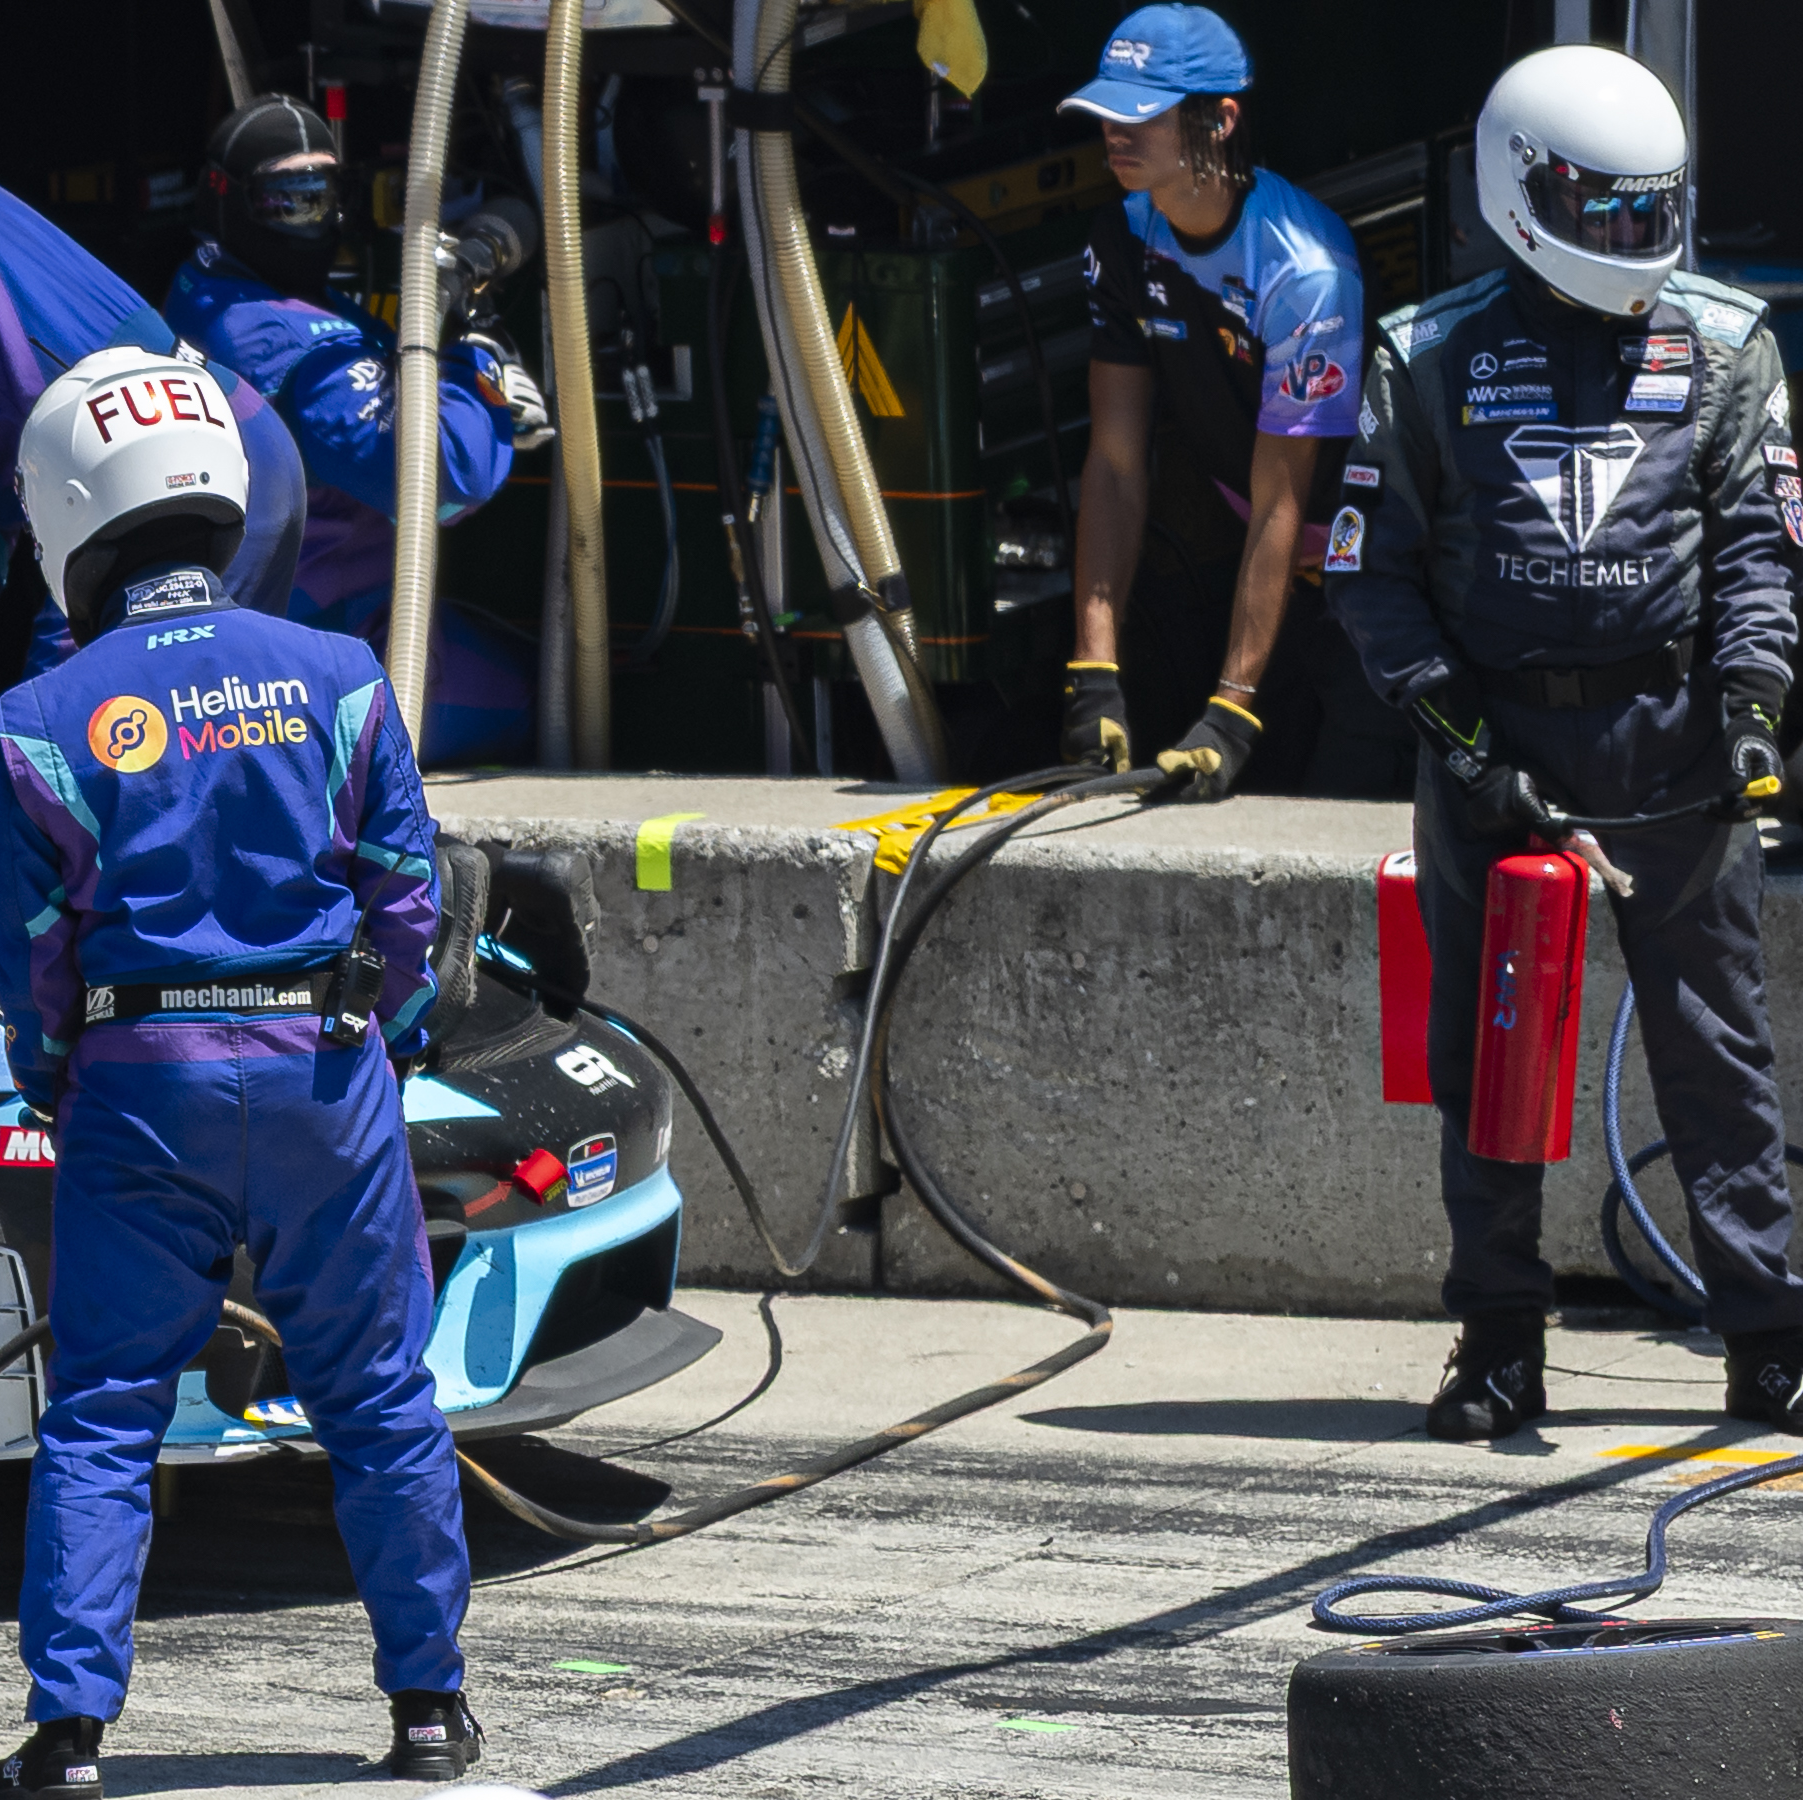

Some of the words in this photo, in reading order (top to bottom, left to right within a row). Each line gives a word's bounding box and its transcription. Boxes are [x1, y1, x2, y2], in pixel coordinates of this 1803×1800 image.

[1610, 166, 1686, 193] IMPACT
[1285, 351, 1329, 402] VP
[85, 378, 226, 445] FUEL
[1495, 552, 1654, 588] TECHEMET
[146, 624, 215, 650] HRX
[170, 676, 309, 723] Helium
[177, 709, 308, 761] Mobile
[160, 983, 312, 1009] mechanix.com
